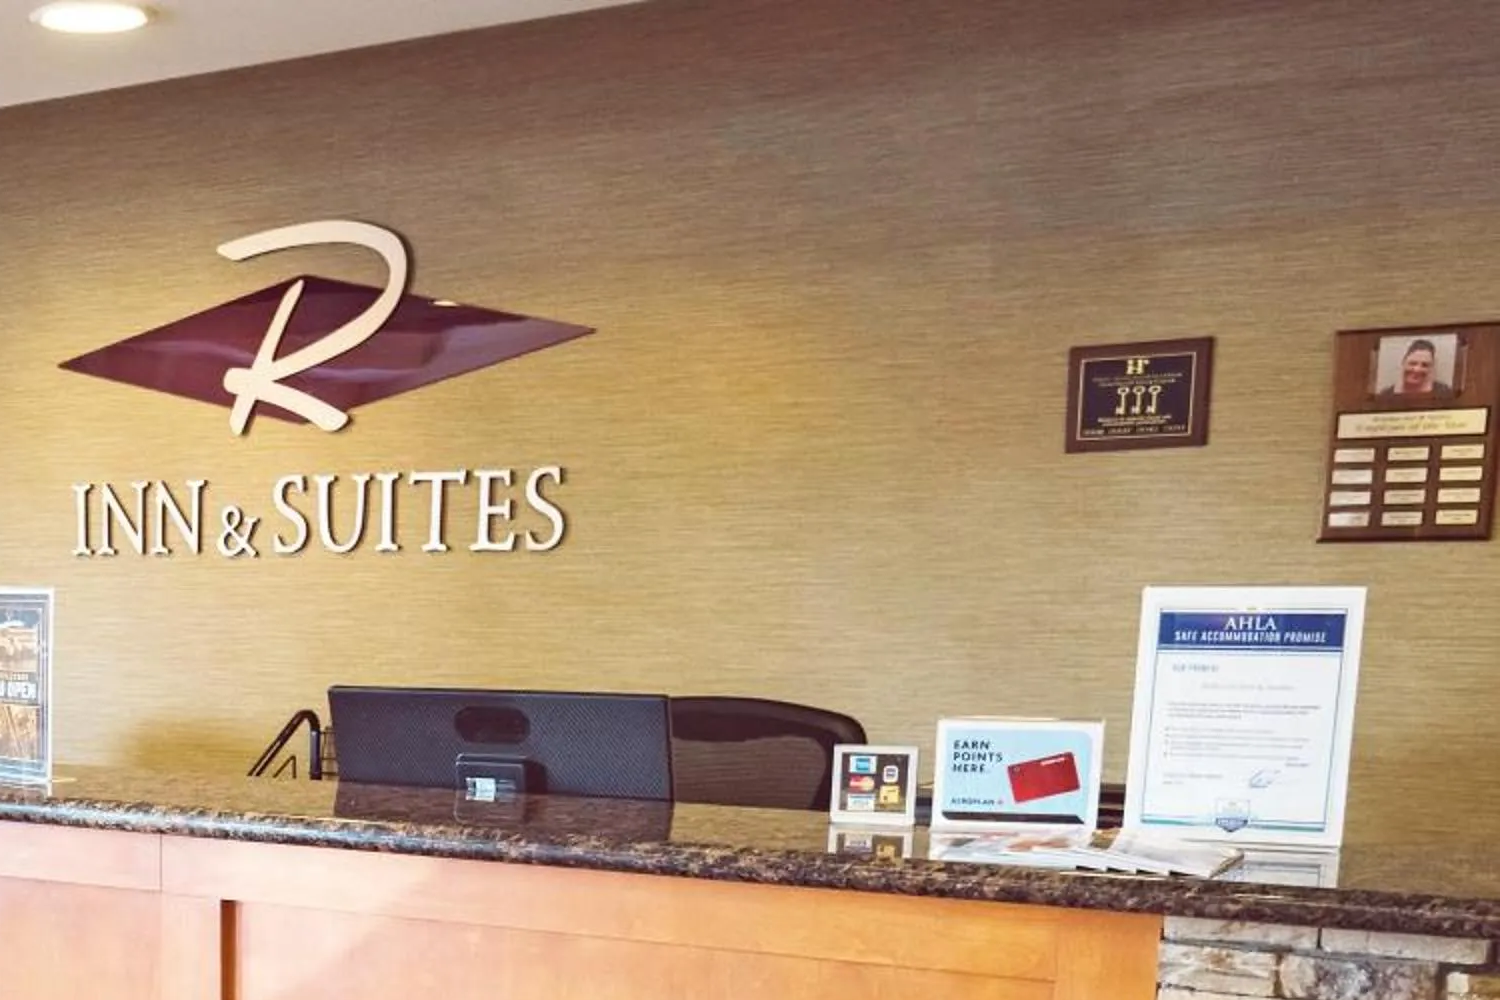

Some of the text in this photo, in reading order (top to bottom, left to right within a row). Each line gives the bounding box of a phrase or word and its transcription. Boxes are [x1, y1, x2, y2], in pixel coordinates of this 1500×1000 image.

[216, 219, 408, 436] R
[71, 465, 567, 558] INN & SUITES
[1223, 615, 1277, 631] AHLA
[1174, 630, 1197, 642] SAFE
[1283, 631, 1327, 644] PROMISE
[953, 739, 991, 750] EARN
[953, 751, 1003, 763] POINTS
